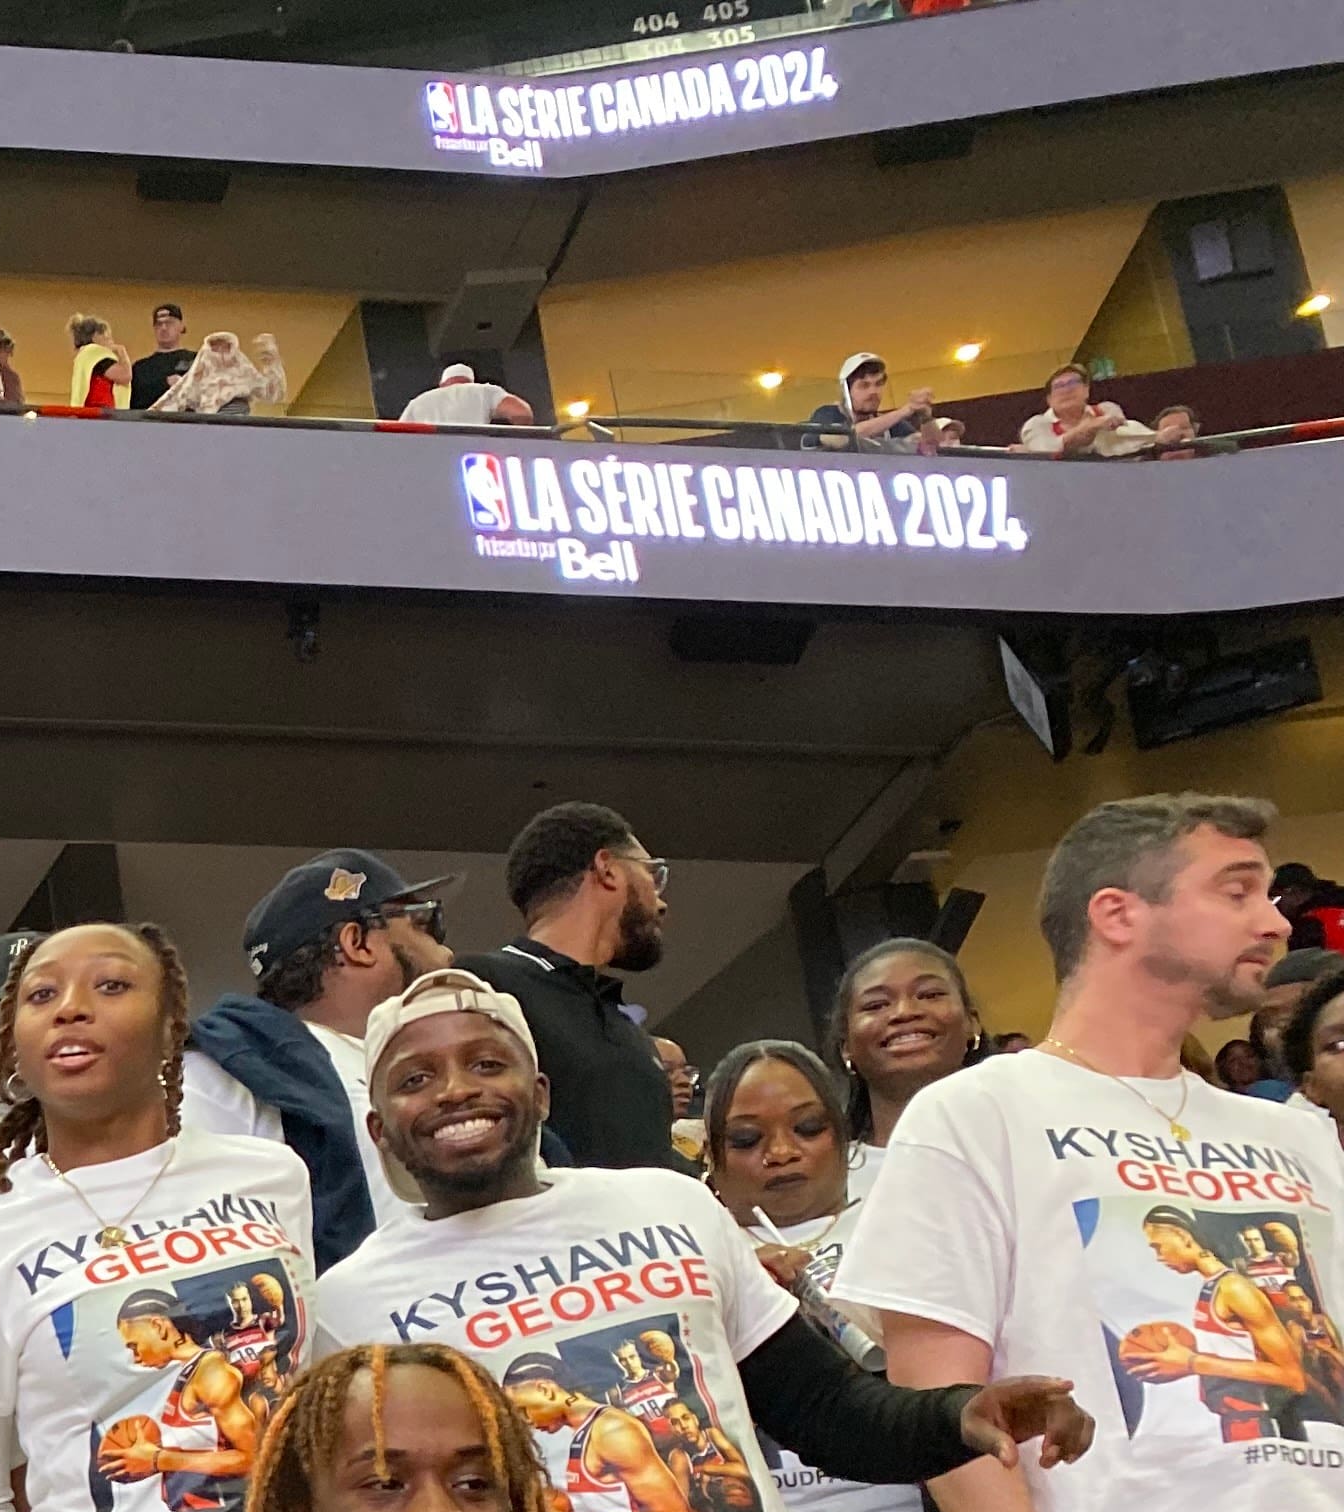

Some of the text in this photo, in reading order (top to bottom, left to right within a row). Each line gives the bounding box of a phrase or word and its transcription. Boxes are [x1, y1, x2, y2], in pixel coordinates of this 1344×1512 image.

[633, 0, 750, 35] 404 405
[709, 25, 756, 48] 305
[456, 47, 838, 140] LA SÉRIE CANADA 2024
[488, 137, 543, 168] Bell
[507, 454, 1028, 552] LA SÉRIE CANADA 2024
[556, 537, 640, 581] Bell
[1046, 1126, 1312, 1185] KYSHAWN
[390, 1223, 703, 1345] KYSHAWN
[465, 1258, 713, 1349] GEORGE
